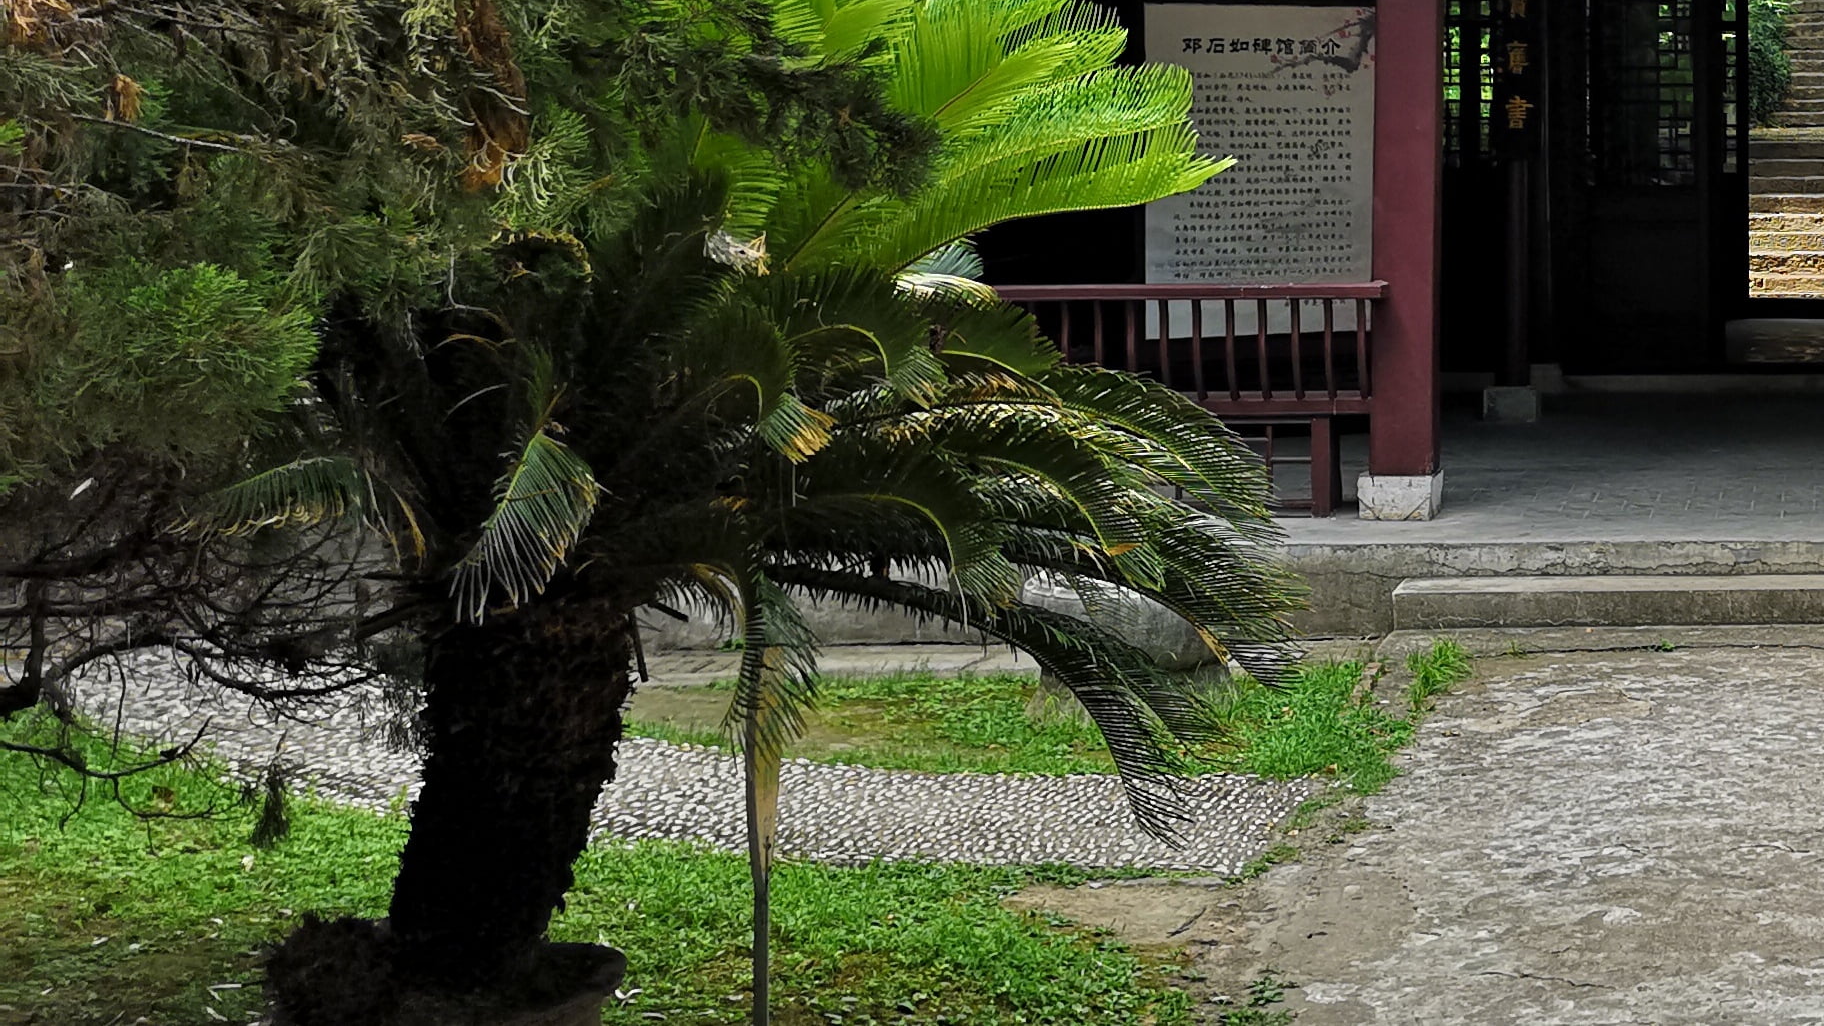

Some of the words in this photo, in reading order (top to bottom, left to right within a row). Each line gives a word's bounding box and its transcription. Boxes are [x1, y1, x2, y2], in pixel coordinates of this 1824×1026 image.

[1181, 36, 1342, 56] 邓石如碑馆简介
